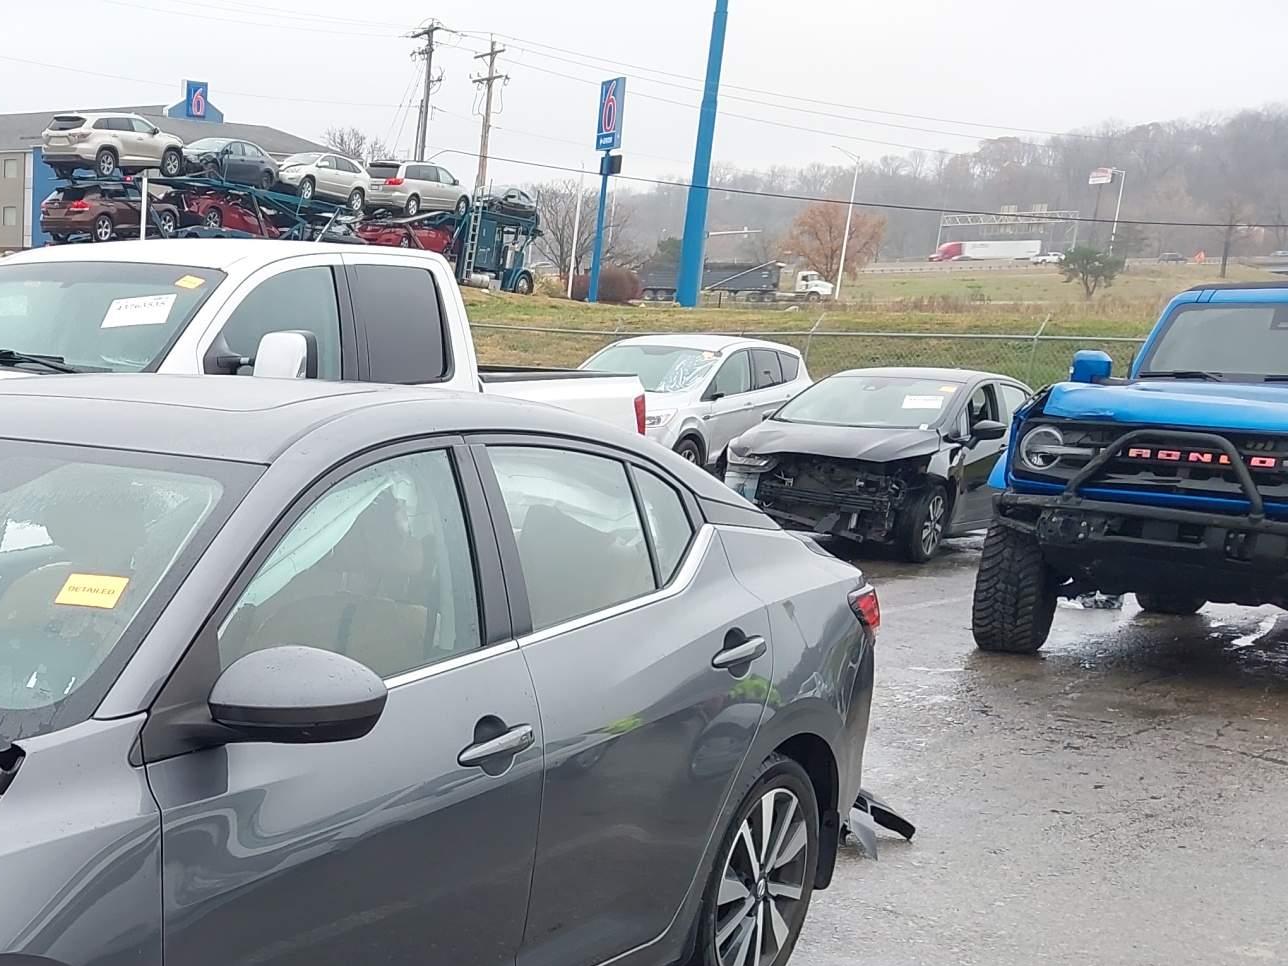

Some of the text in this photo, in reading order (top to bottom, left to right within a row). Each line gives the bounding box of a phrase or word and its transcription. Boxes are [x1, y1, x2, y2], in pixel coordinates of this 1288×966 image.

[192, 87, 205, 116] 6
[602, 80, 617, 133] 6
[67, 584, 116, 595] DETAILED
